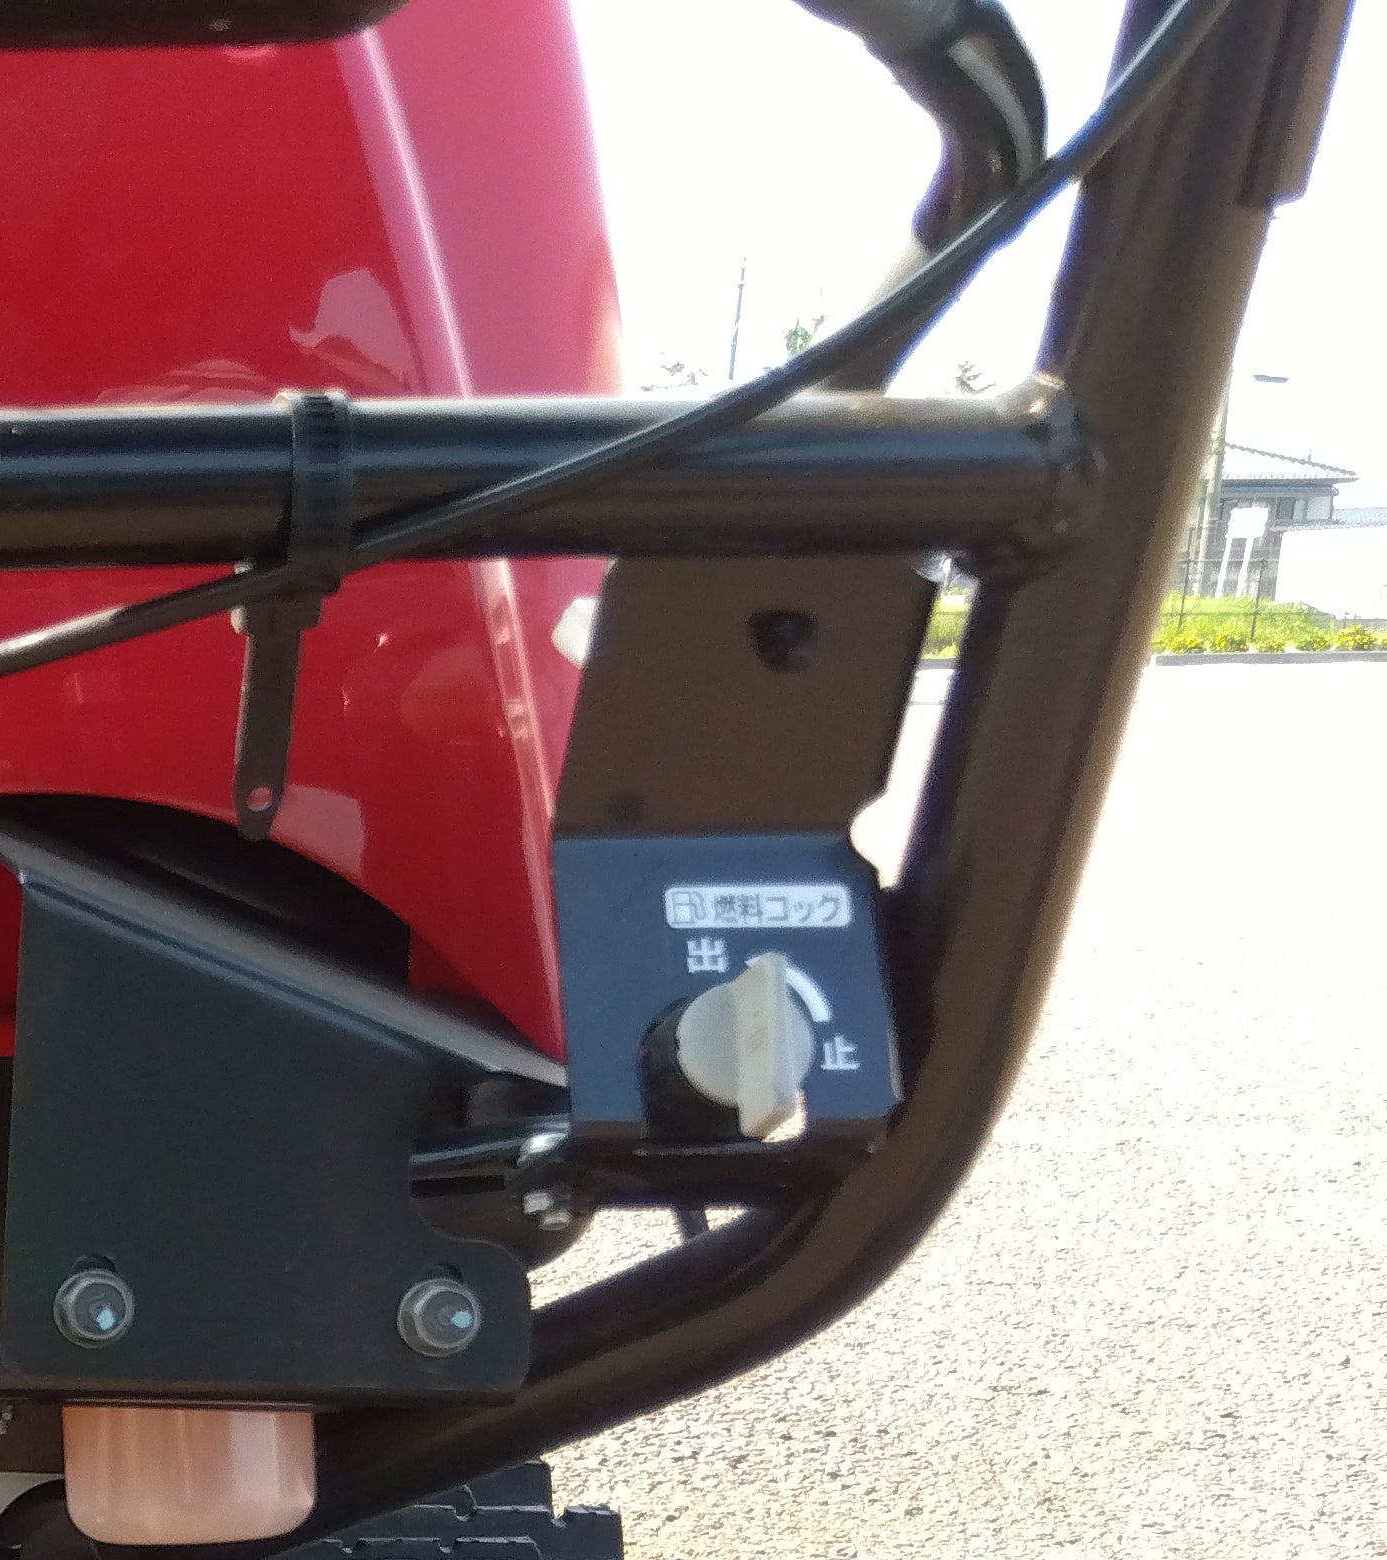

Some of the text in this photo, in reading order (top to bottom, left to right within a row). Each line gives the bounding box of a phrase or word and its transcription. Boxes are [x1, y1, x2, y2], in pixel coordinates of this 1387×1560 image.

[714, 893, 841, 924] 燃料コック
[687, 937, 728, 973] 出
[821, 1035, 861, 1070] 止
